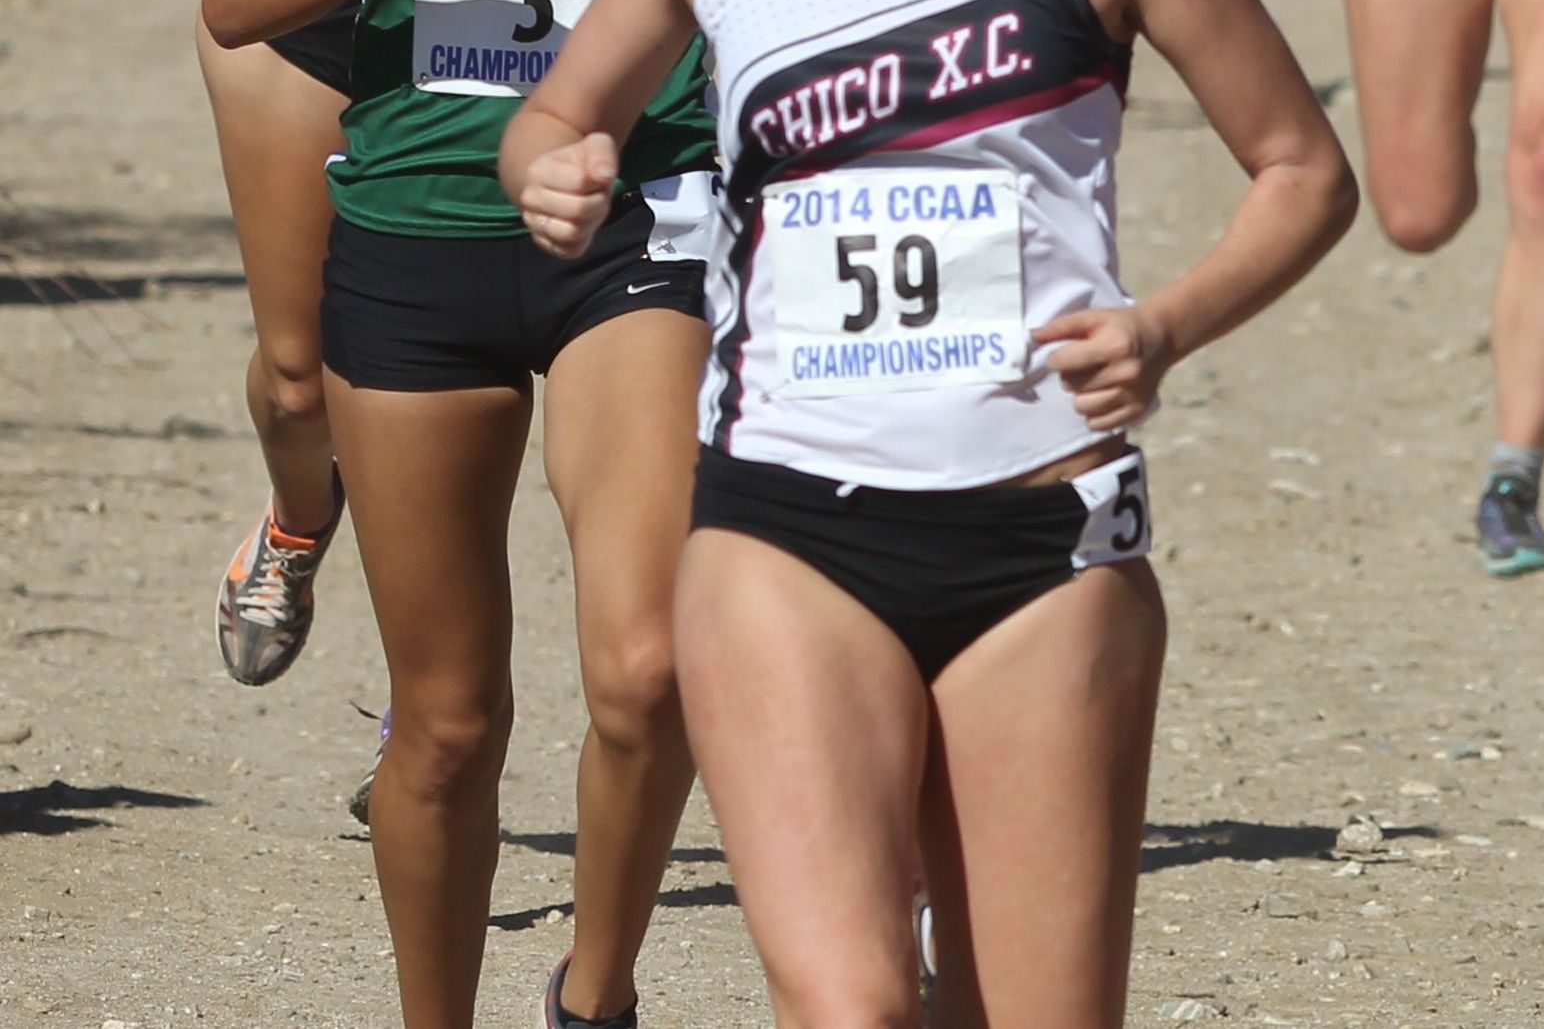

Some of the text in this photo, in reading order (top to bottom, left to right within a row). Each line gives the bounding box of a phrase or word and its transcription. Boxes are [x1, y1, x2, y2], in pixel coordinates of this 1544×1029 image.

[750, 12, 1034, 160] CHICO X.C.
[782, 182, 997, 229] 2014 CCAA
[836, 233, 940, 334] 59
[792, 332, 1006, 381] CHAMPIONSHIPS
[1110, 465, 1144, 552] 5
